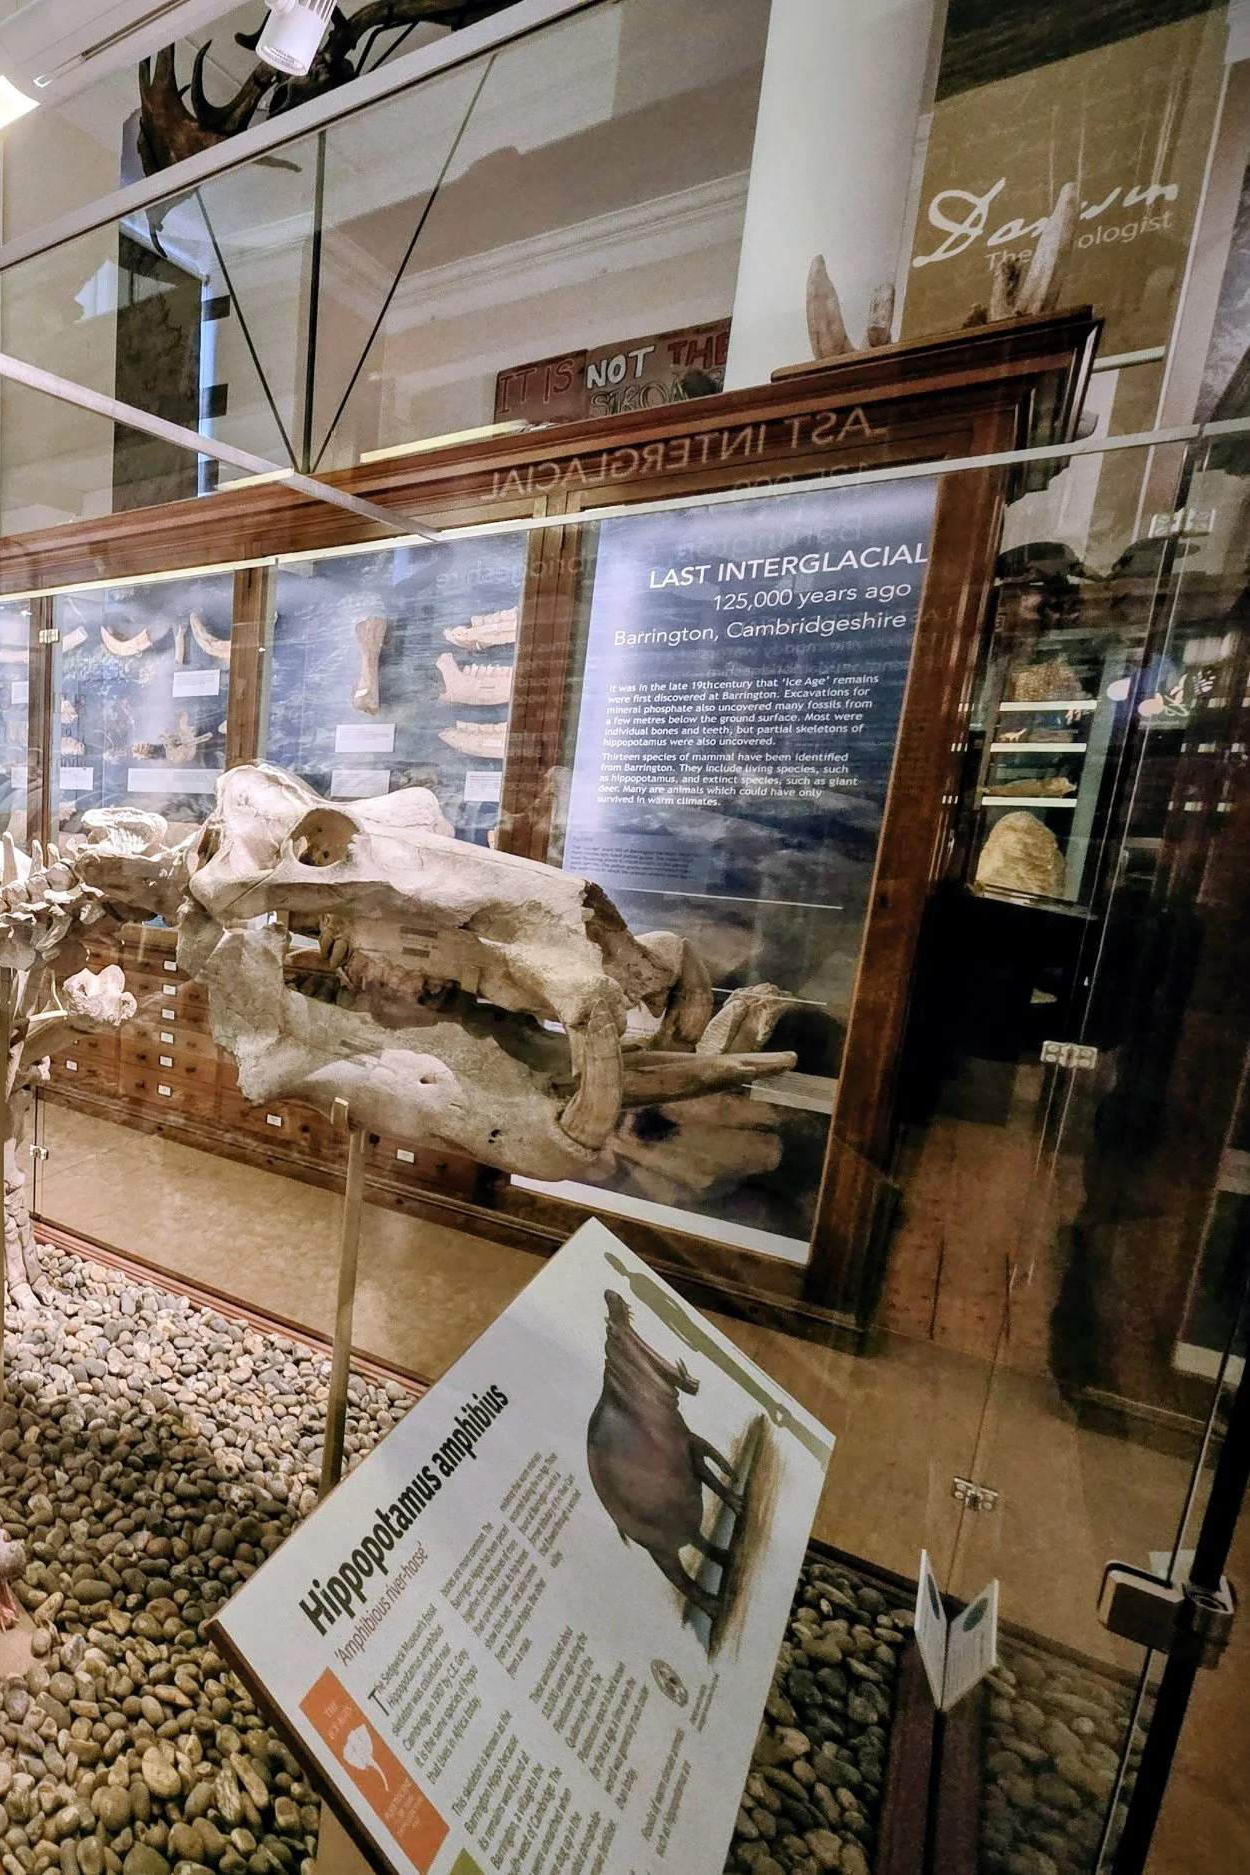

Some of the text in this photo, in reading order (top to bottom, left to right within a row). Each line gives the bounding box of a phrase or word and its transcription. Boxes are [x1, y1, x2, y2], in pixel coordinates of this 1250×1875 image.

[1077, 210, 1173, 249] ologist
[498, 367, 536, 415] IT
[543, 358, 575, 405] IS
[586, 345, 656, 390] NOT
[667, 331, 731, 369] THE
[650, 543, 930, 589] LAST INTERGLACIAL
[713, 583, 911, 611] 125,000 years ago
[614, 612, 907, 647] Barrington, Cambridgeshire
[609, 684, 616, 692] It
[639, 683, 648, 692] in
[650, 682, 666, 692] the
[669, 682, 688, 691] late
[756, 679, 778, 688] that
[833, 675, 879, 685] remains
[633, 694, 652, 703] first
[654, 692, 706, 702] discovered
[708, 692, 719, 700] at
[722, 689, 780, 701] Barrington.
[784, 687, 849, 699] Excavations
[853, 686, 871, 696] for
[606, 699, 873, 715] mineral phosphate also uncovered many fossils from
[613, 716, 630, 725] few
[633, 716, 666, 725] metres
[668, 715, 697, 724] below
[700, 715, 717, 723] the
[719, 713, 755, 725] ground
[758, 713, 801, 723] surface.
[804, 712, 831, 721] Most
[834, 713, 863, 721] were
[605, 723, 865, 736] individual bones and teeth, but partial skeletons of
[603, 738, 667, 748] hippopotamus
[696, 738, 716, 746] also
[719, 737, 776, 746] uncovered.
[602, 752, 849, 763] Thirteen species of mammal have been identified
[600, 763, 849, 775] from Barrington. They include living species, such
[599, 774, 609, 782] as
[612, 774, 678, 784] hippopotamus,
[682, 775, 700, 784] and
[703, 775, 738, 784] extinct
[741, 776, 782, 786] species,
[786, 776, 811, 785] such
[829, 777, 859, 787] giant
[597, 784, 620, 793] deer.
[623, 785, 647, 795] Many
[667, 786, 704, 794] animals
[707, 786, 736, 795] which
[739, 787, 768, 796] could
[770, 788, 796, 797] have
[798, 788, 822, 799] only
[597, 795, 721, 806] survived in warm climates.
[299, 1384, 508, 1636] Hippopotamus amphibius
[381, 1650, 406, 1685] Sedgwick
[421, 1603, 437, 1625] fossil
[386, 1624, 443, 1709] Hippopotamus amphibius
[461, 1665, 478, 1686] hippo
[392, 1642, 451, 1737] skeleton was collected near
[441, 1676, 452, 1688] by
[458, 1682, 468, 1695] of
[431, 1682, 444, 1705] 1907
[428, 1701, 436, 1712] in
[444, 1692, 462, 1719] species
[402, 1709, 431, 1751] Cambridge
[432, 1717, 447, 1740] same
[422, 1736, 436, 1753] the
[426, 1696, 481, 1784] that lives in Africa today.
[417, 1750, 428, 1761] is
[451, 1710, 512, 1816] This skeleton is known as the
